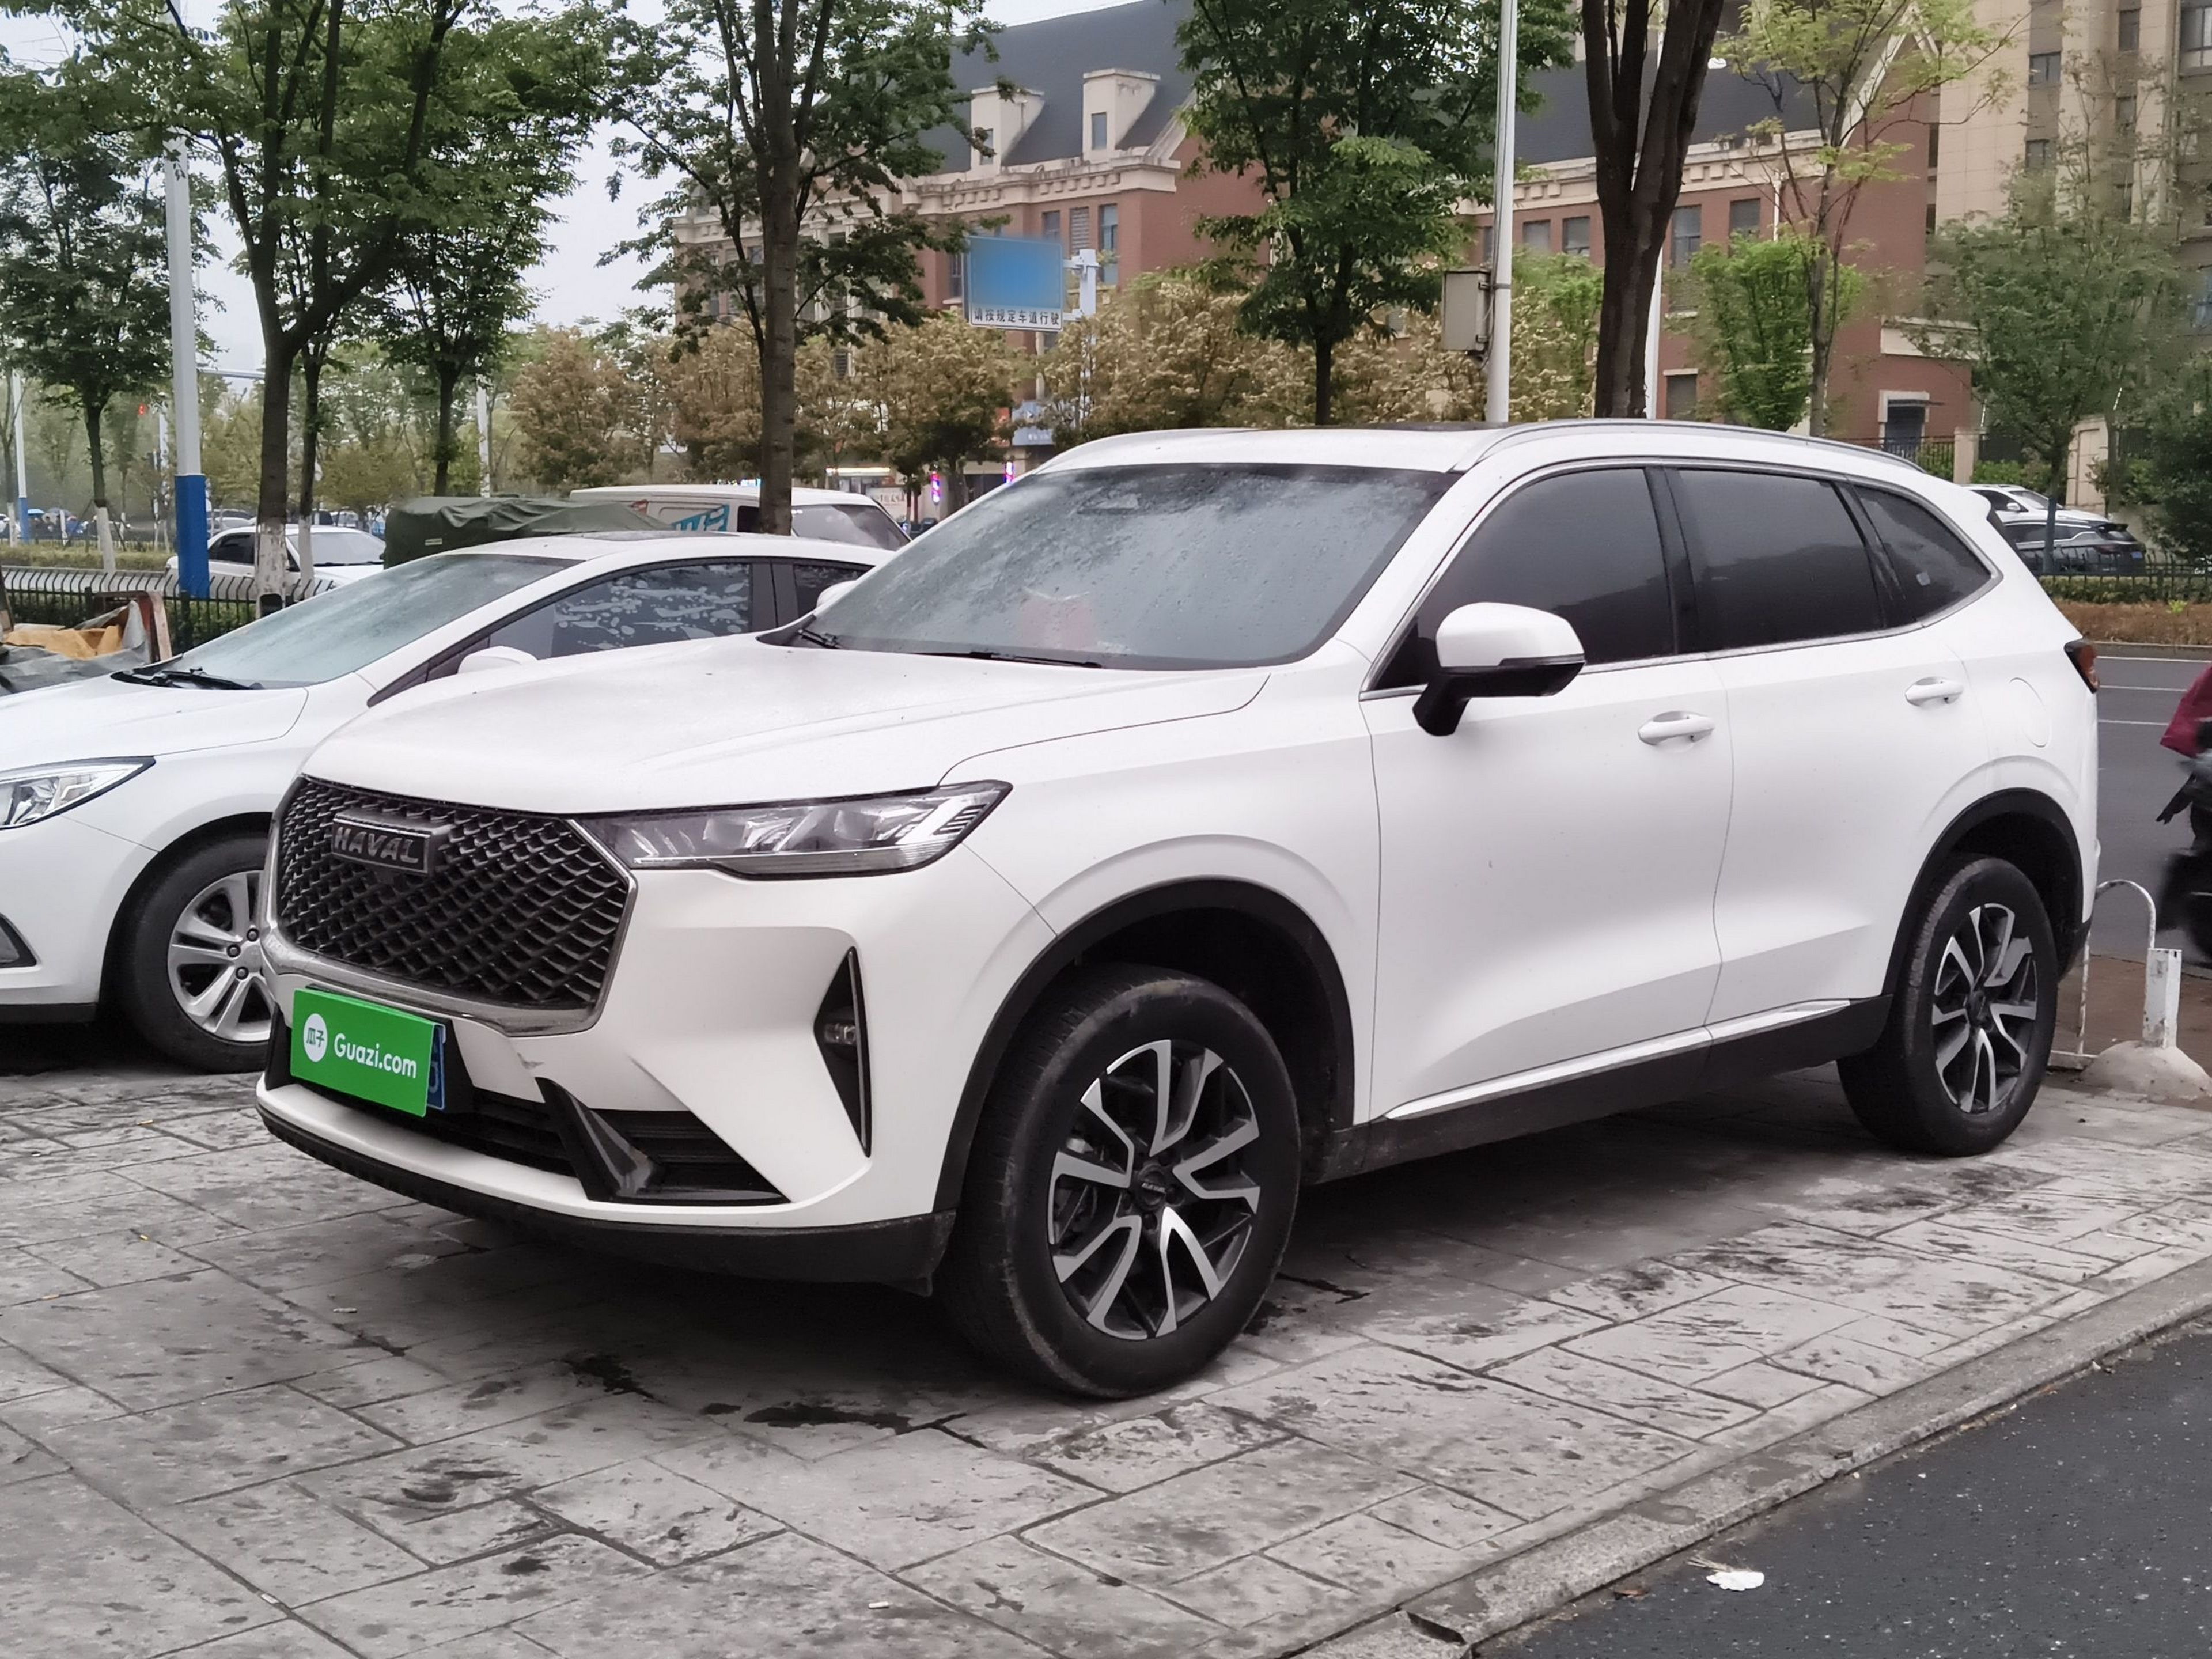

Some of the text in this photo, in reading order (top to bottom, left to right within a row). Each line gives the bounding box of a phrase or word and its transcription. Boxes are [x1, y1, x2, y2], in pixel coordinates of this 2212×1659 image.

[334, 826, 419, 864] HAVAL
[306, 1027, 325, 1048] 瓜子
[334, 1032, 417, 1079] Guazi.com
